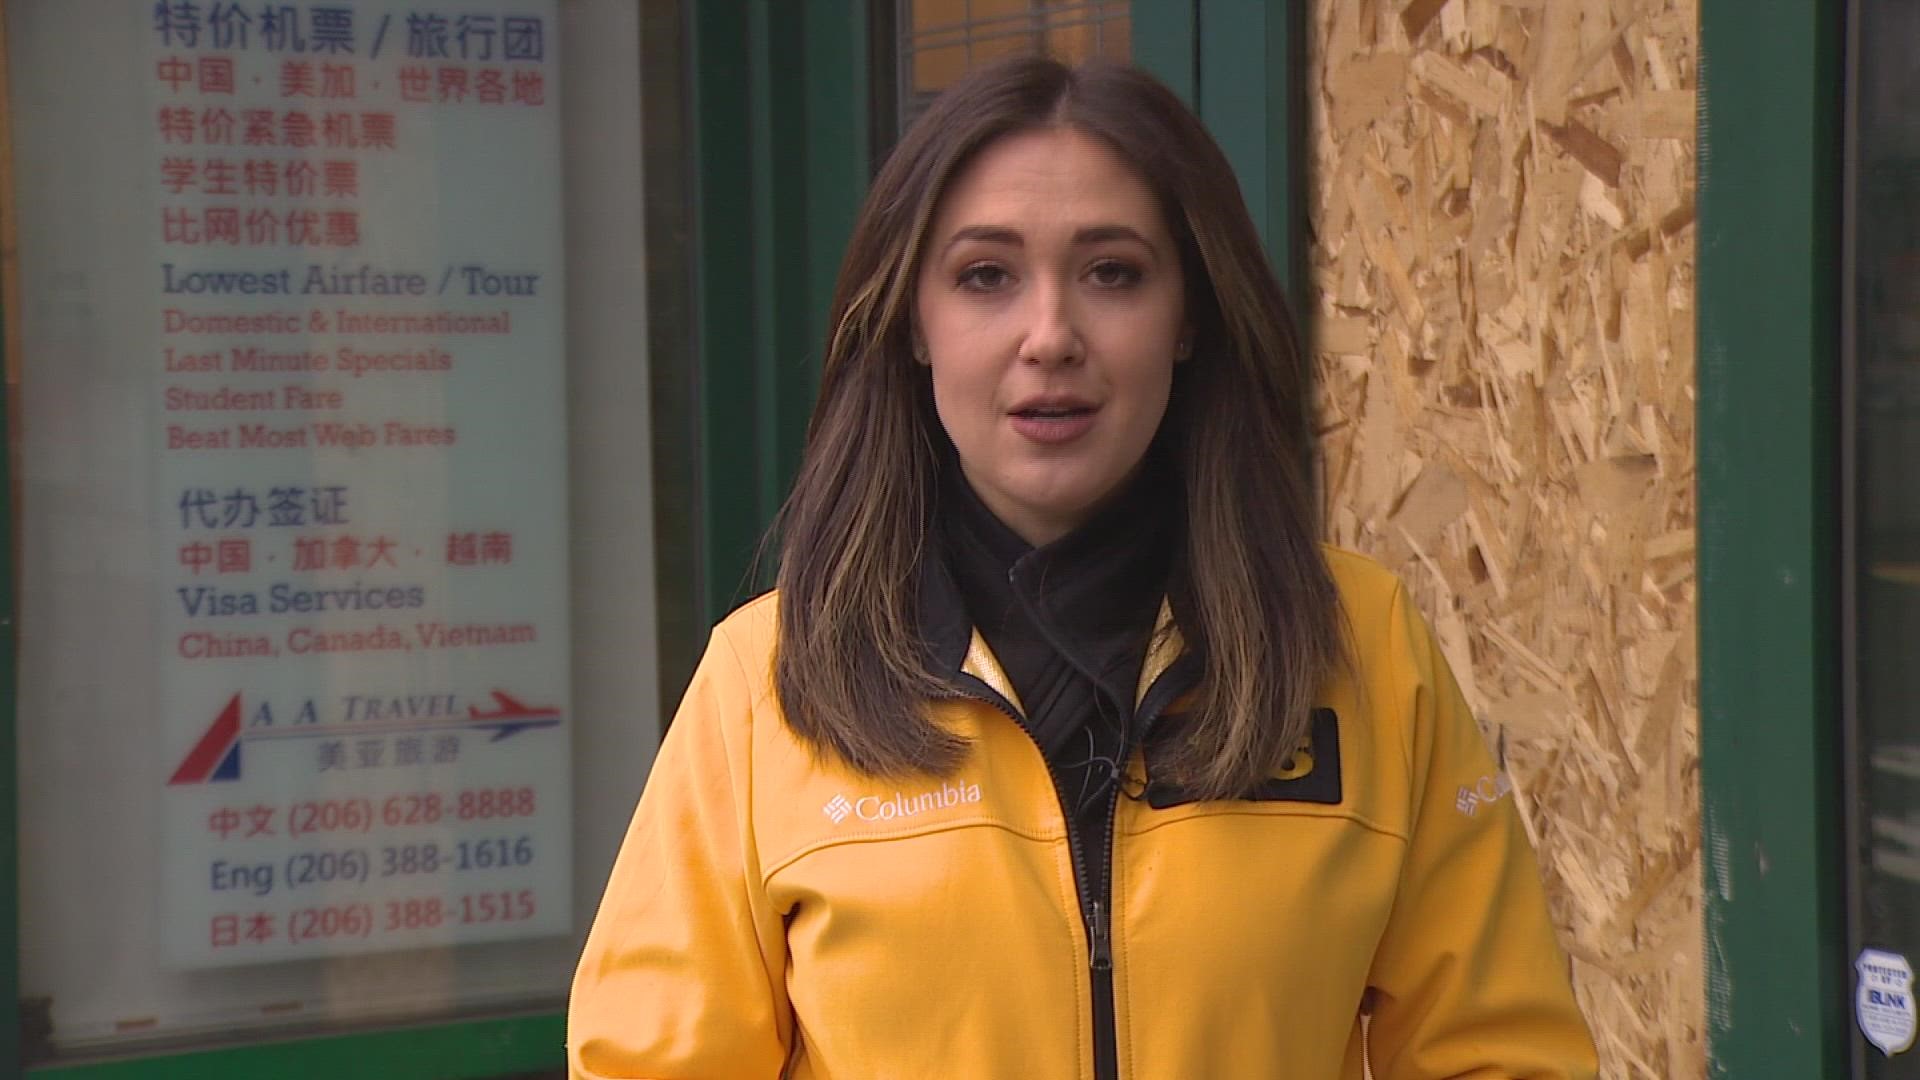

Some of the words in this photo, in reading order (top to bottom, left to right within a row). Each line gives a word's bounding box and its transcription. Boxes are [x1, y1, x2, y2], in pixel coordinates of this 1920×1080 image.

[154, 0, 355, 53] 特价机票
[405, 12, 545, 62] 旅行团
[158, 56, 235, 95] 中国
[280, 60, 355, 98] 美加
[397, 66, 545, 106] 世界各地
[158, 106, 396, 149] 特价紧急机票
[161, 157, 359, 198] 学生特价票
[162, 207, 360, 247] 比网价优惠
[162, 263, 291, 295] Lowest
[301, 264, 426, 296] Airfare
[460, 266, 541, 296] Tour
[163, 309, 301, 335] Domestic
[308, 310, 329, 334] &
[336, 308, 512, 335] International
[163, 347, 223, 372] Last
[231, 348, 329, 372] Minute
[336, 347, 453, 378] Specials
[164, 387, 277, 412] Student
[283, 385, 344, 409] Fare
[167, 425, 231, 450] Beat
[238, 424, 308, 449] Most
[314, 423, 378, 447] Web
[384, 421, 457, 446] Fares
[178, 486, 350, 529] 代办签证
[180, 540, 251, 575] 中国
[293, 533, 398, 572] 加拿大
[446, 531, 513, 566] 越南
[177, 587, 258, 617] Visa
[268, 581, 425, 614] Services
[178, 631, 280, 658] China,
[287, 625, 412, 655] Canada,
[416, 622, 538, 650] Vietnam
[342, 694, 461, 722] TRAVEL
[316, 735, 462, 772] 美亚旅游
[209, 804, 278, 840] 中文
[288, 797, 373, 836] (206)
[383, 787, 536, 828] 628-8888
[855, 780, 981, 821] Columbia
[210, 860, 275, 895] Eng
[285, 849, 370, 888] (206)
[380, 837, 534, 878] 388-1616
[210, 912, 278, 947] 日本
[287, 902, 374, 944] (206)
[384, 890, 537, 931] 388-1515
